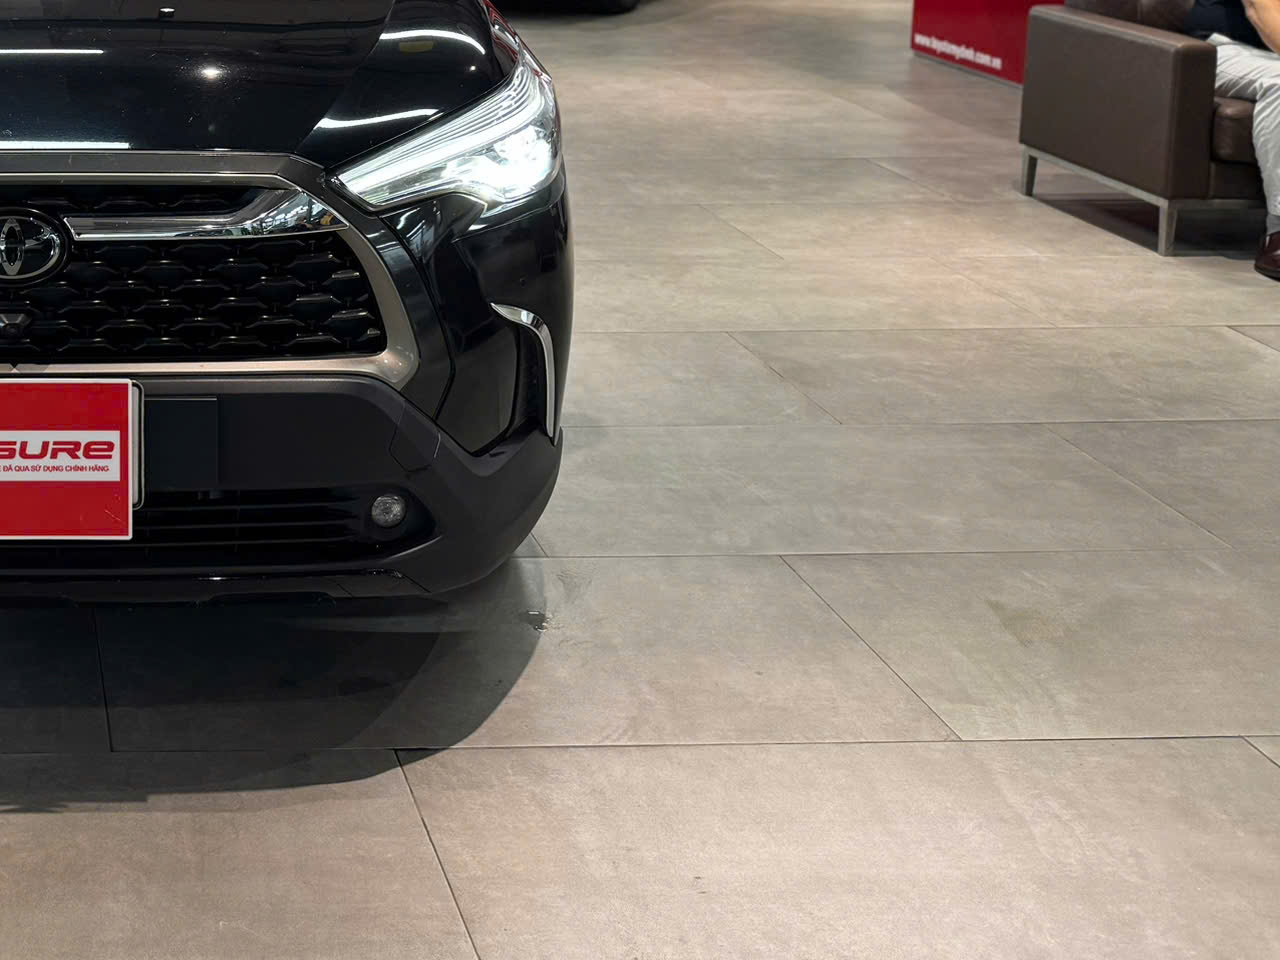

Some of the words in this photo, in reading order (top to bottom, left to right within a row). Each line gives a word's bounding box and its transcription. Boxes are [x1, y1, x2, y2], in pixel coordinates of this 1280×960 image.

[3, 464, 14, 472] ĐÃ
[30, 464, 41, 472] SỬ
[43, 465, 64, 473] DỤNG
[65, 464, 87, 472] CHÍNH
[88, 464, 110, 472] HÃNG
